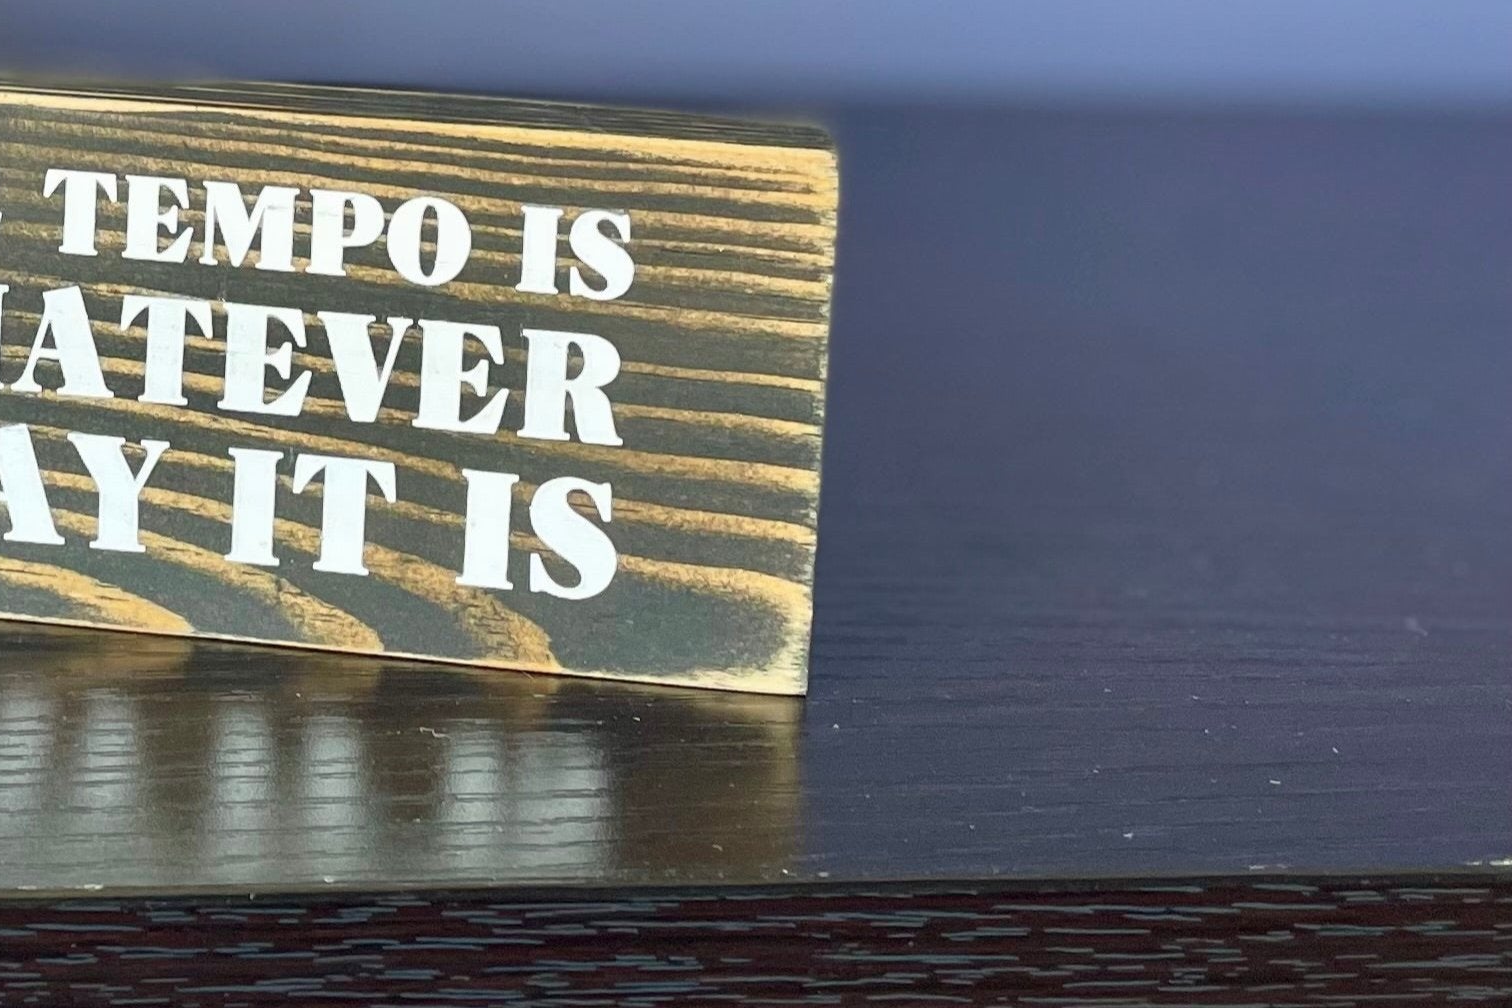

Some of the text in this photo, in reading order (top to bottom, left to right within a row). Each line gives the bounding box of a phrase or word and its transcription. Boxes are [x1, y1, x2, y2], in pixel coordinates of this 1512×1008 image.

[43, 168, 472, 288] TEMPO
[515, 203, 636, 301] IS
[224, 445, 398, 577] IT
[455, 467, 618, 601] IS
